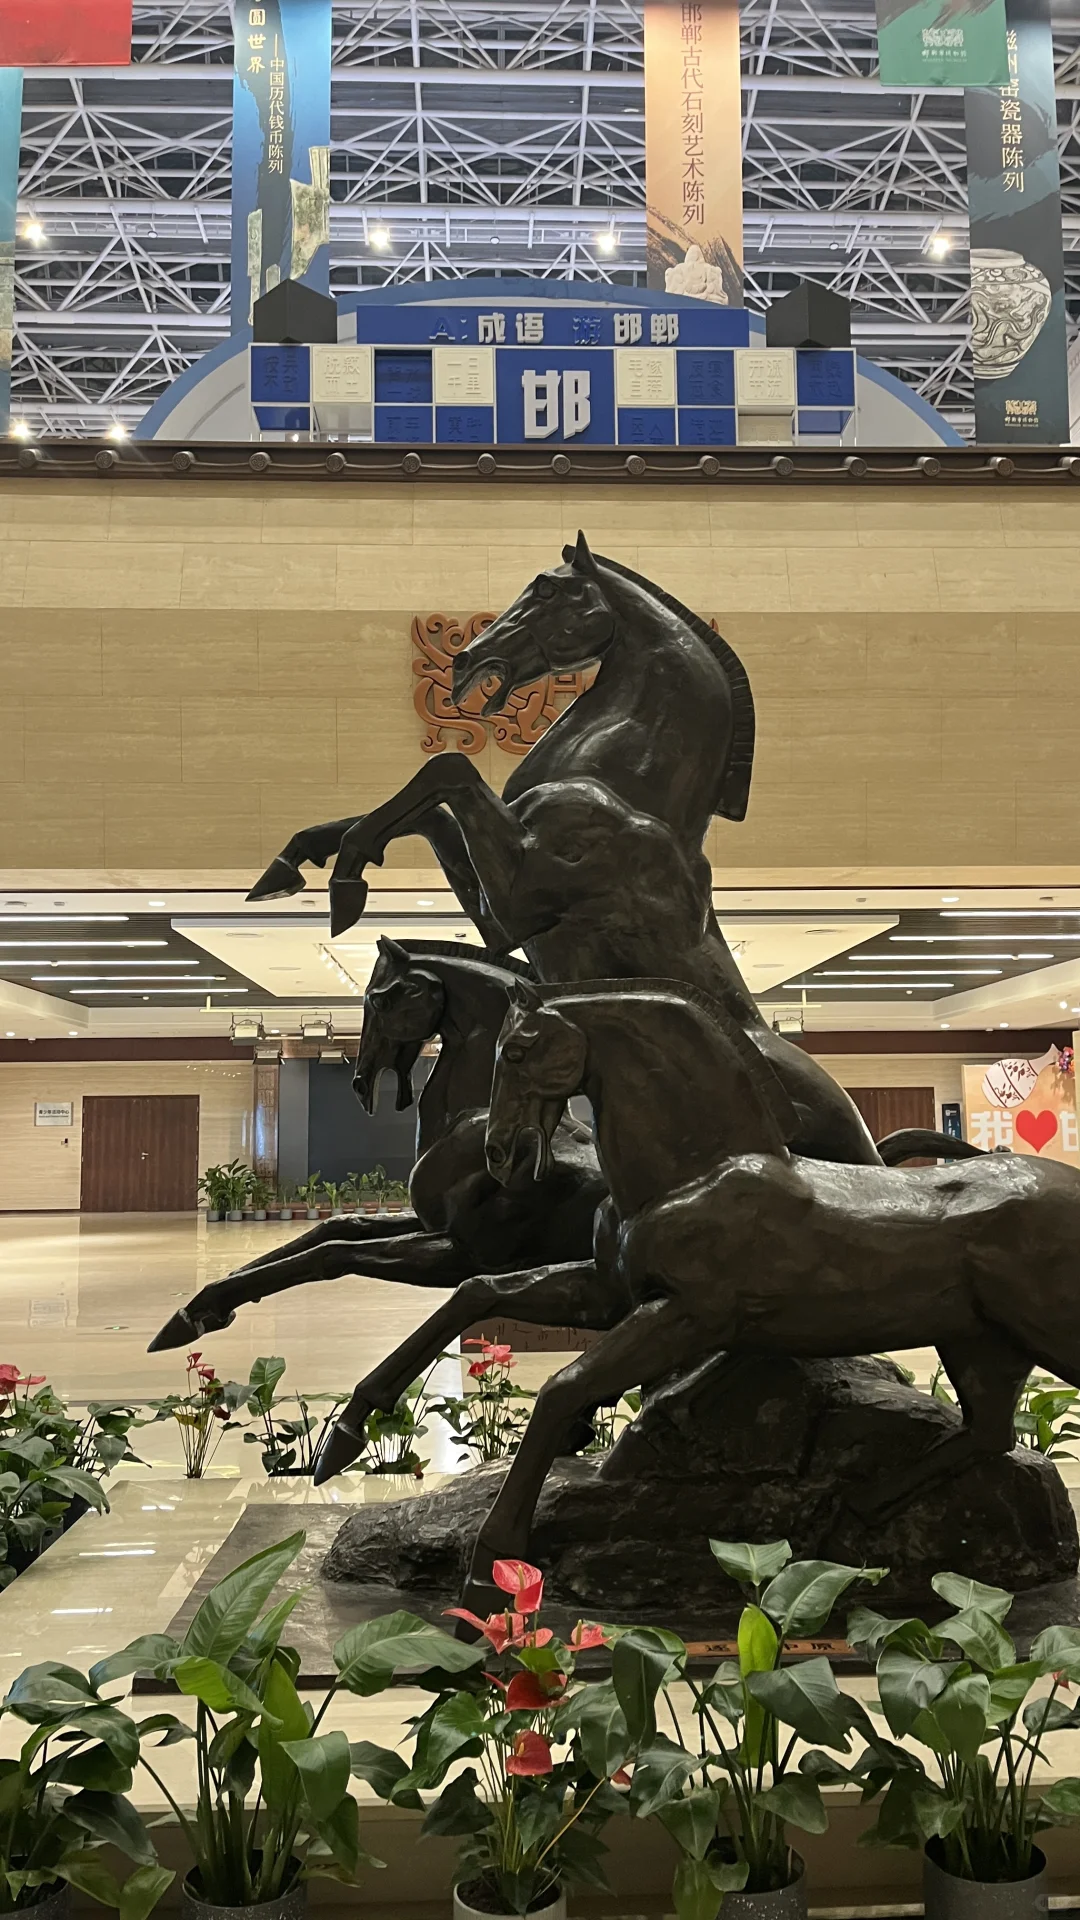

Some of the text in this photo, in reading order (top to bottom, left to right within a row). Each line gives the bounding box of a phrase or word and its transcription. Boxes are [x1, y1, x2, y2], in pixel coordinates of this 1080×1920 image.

[680, 2, 705, 226] 邯郸古代石刻艺术陈列
[522, 369, 591, 440] 邯
[971, 1111, 1014, 1153] 我
